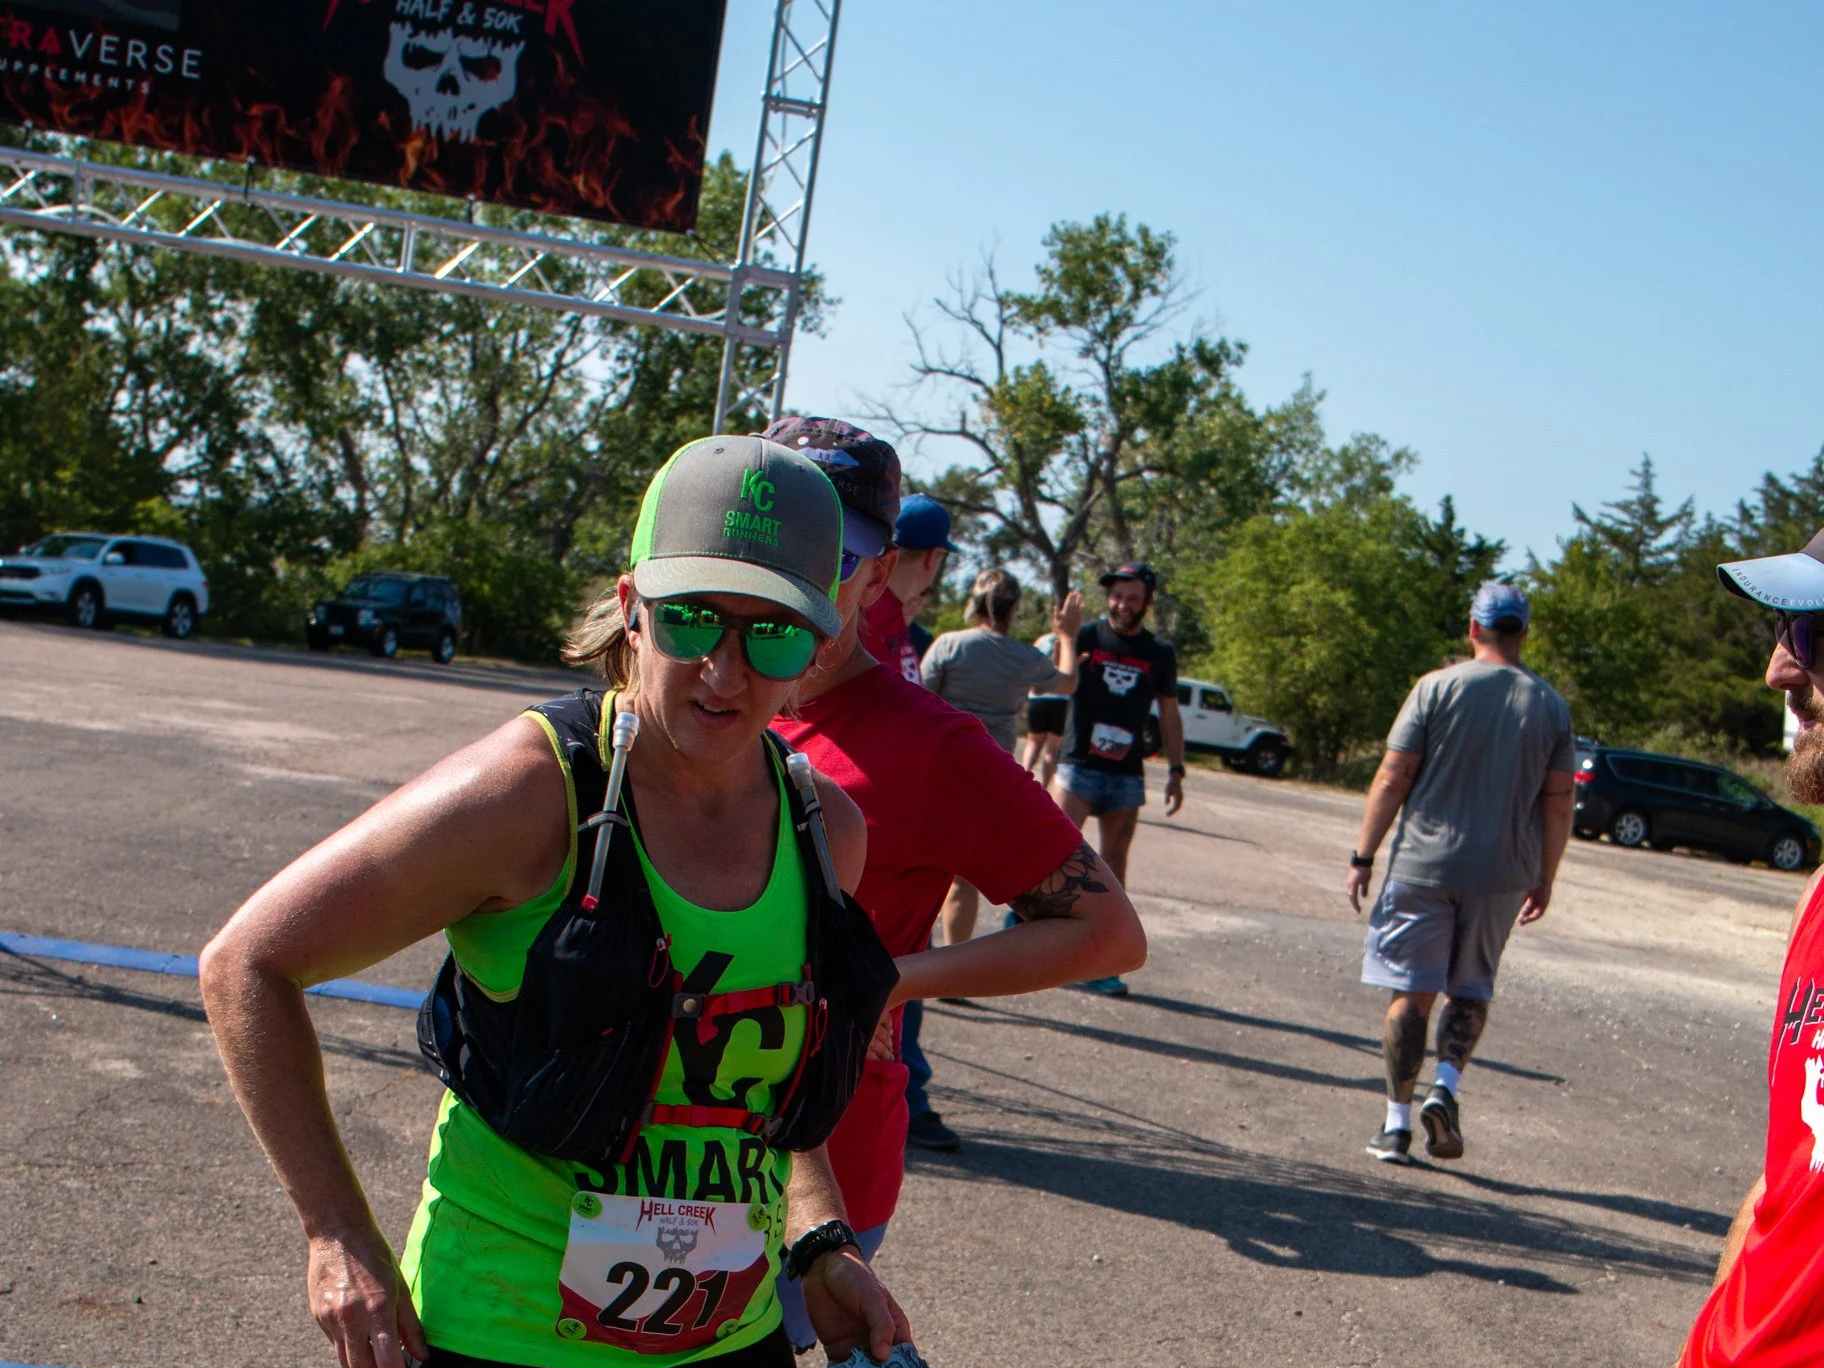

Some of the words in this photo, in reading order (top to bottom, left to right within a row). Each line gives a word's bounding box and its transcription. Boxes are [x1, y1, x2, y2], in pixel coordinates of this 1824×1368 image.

[457, 2, 476, 26] &
[483, 7, 524, 34] 50K
[740, 468, 776, 512] KC
[722, 527, 781, 548] RUNNERS
[724, 510, 783, 537] SMART
[1789, 597, 1824, 608] EVOL
[1772, 976, 1824, 1087] HE
[635, 1198, 675, 1233] HELL
[677, 1204, 717, 1237] CREEK
[597, 1261, 731, 1336] 221
